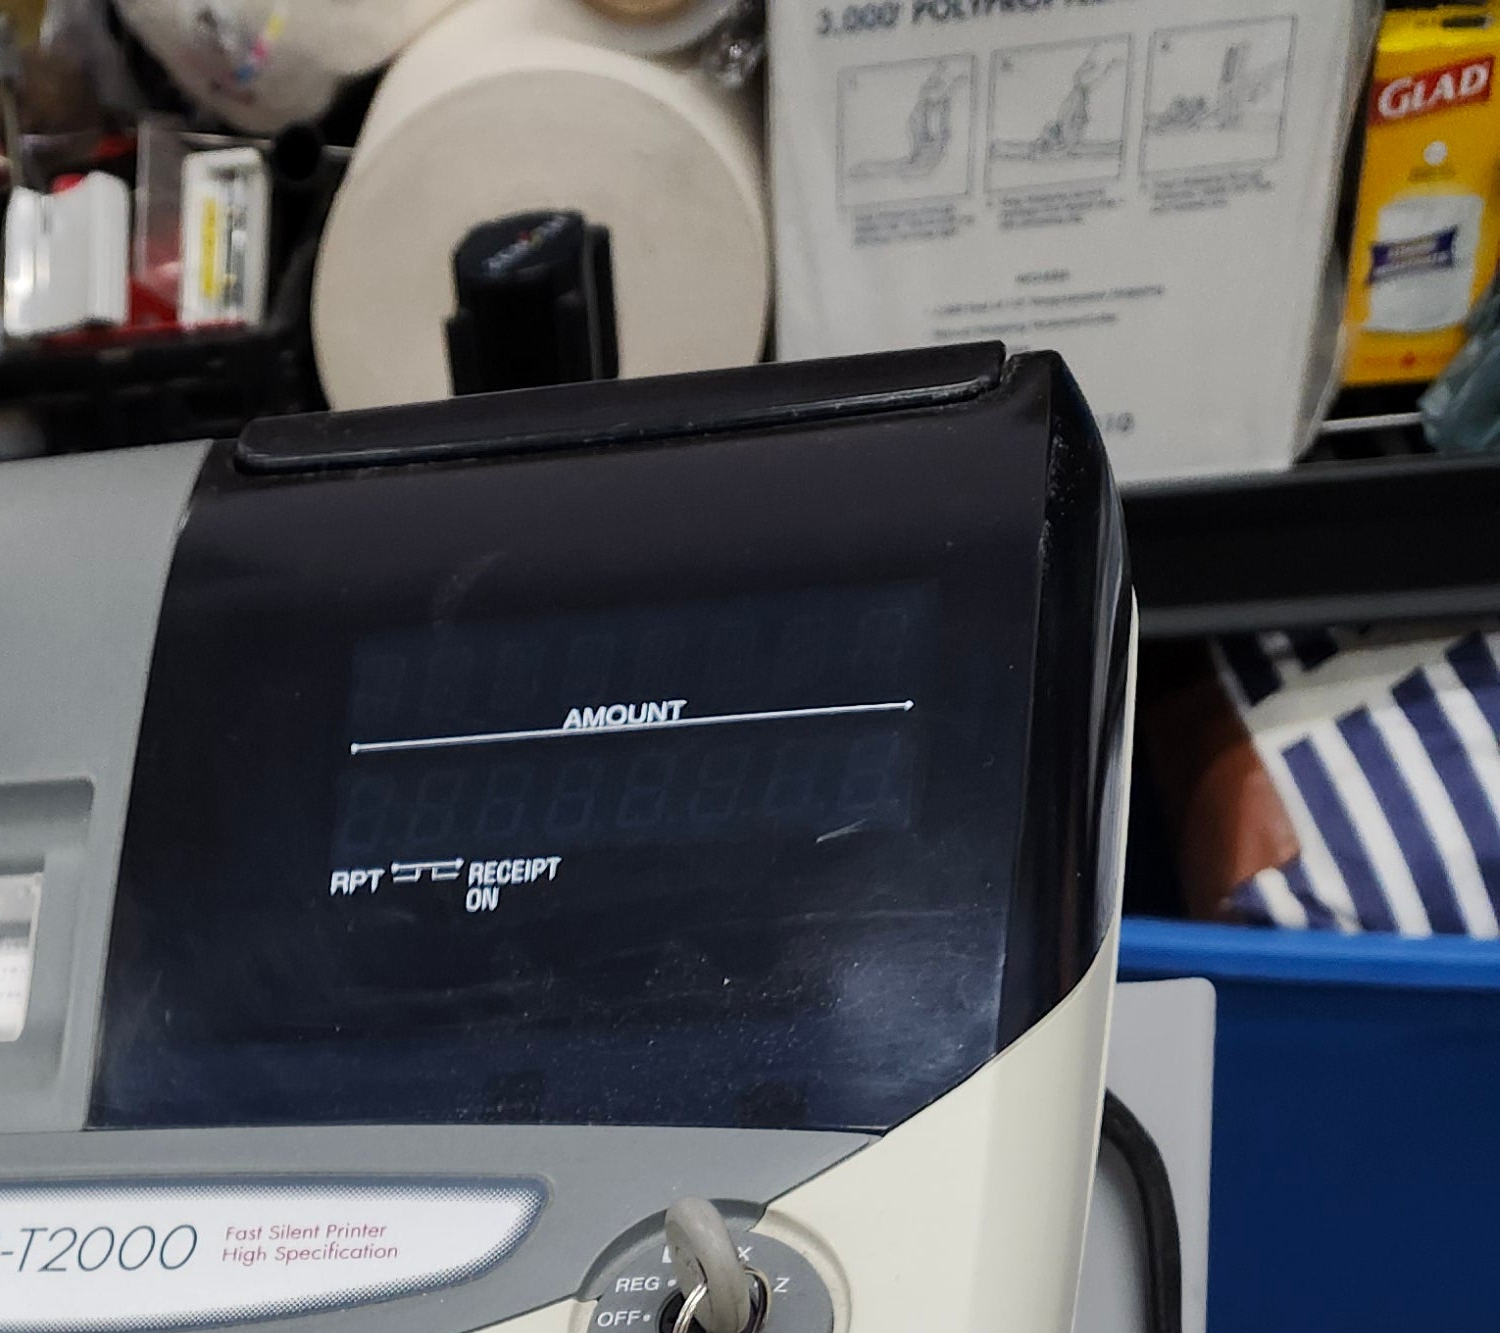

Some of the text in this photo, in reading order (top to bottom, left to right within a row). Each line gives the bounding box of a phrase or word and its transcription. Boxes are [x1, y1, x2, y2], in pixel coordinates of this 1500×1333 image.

[1378, 62, 1491, 119] GLAD
[562, 699, 688, 728] AMOUNT
[329, 856, 562, 896] RPT RECEIPT
[466, 886, 499, 912] ON
[225, 1223, 387, 1240] Fast Silent Printer
[222, 1241, 397, 1266] High Specification
[615, 1277, 660, 1291] REG
[773, 1277, 790, 1292] Z
[598, 1311, 641, 1327] OFF
